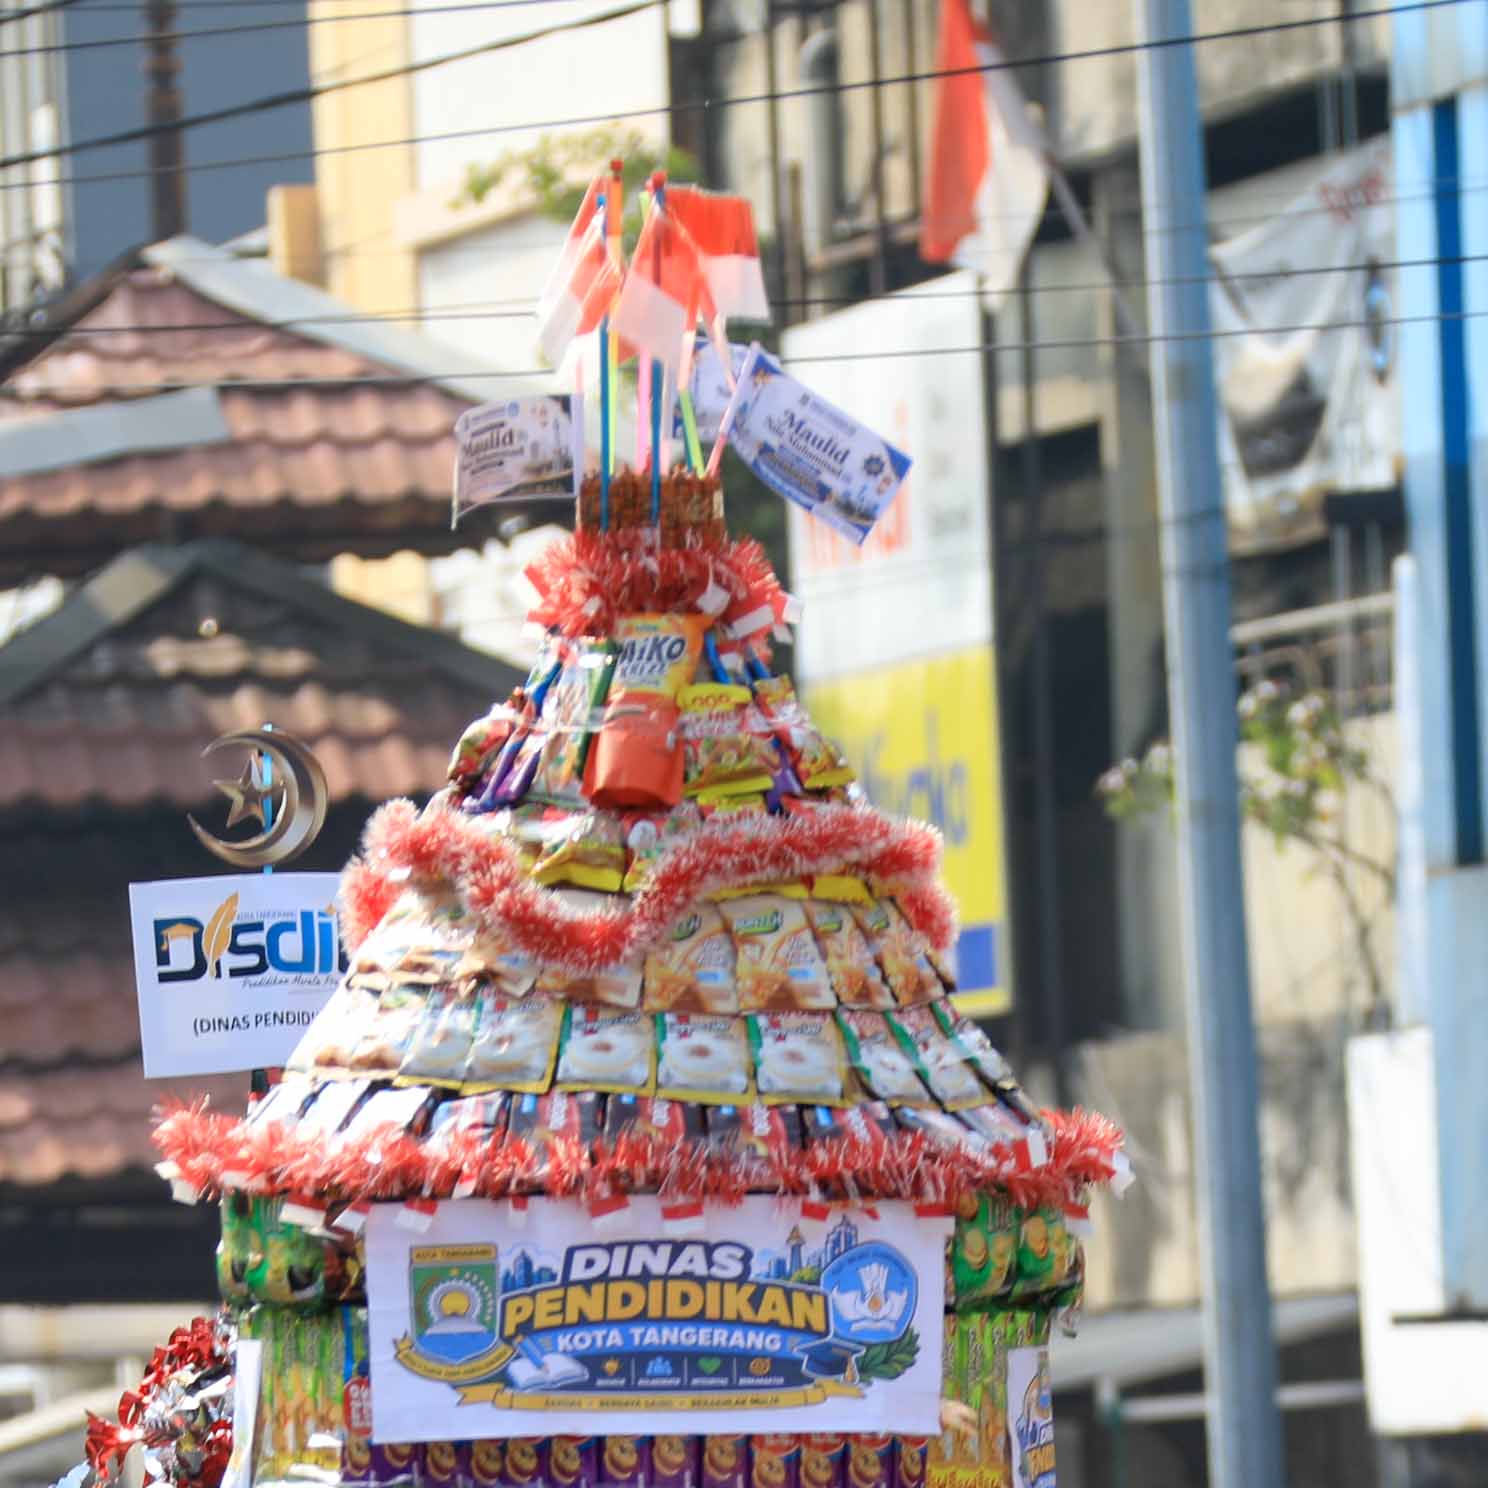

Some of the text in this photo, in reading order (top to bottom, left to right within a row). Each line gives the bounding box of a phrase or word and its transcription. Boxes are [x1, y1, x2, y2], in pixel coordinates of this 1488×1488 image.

[784, 409, 851, 466] Maulid
[193, 1010, 251, 1037] (DINAS
[567, 1244, 749, 1281] DINAS
[502, 1280, 829, 1337] PENDIDIKAN
[557, 1326, 784, 1352] KOTA TANGERANG
